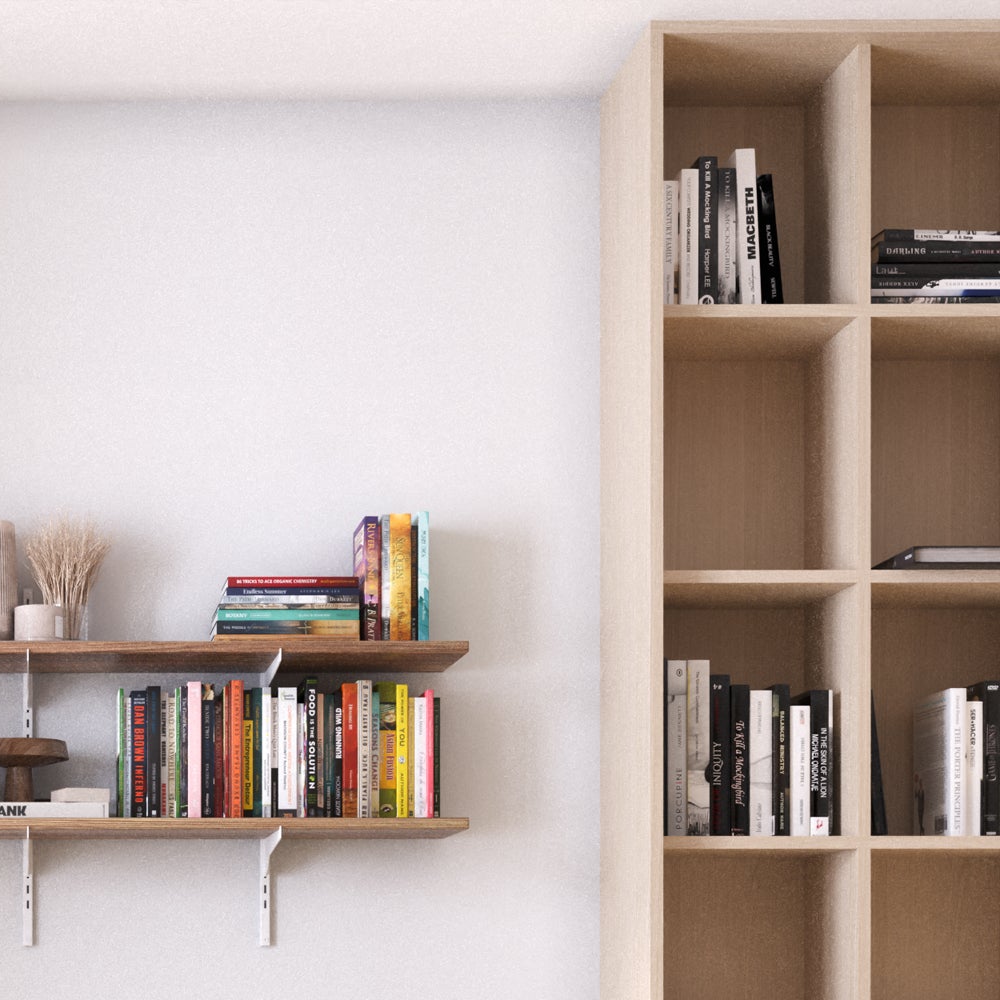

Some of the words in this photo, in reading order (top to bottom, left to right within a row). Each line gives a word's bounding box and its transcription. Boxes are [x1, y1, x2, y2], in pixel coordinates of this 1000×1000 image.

[703, 160, 711, 169] To
[703, 171, 711, 181] Kill
[724, 171, 731, 184] TO
[703, 191, 711, 222] Mocking
[703, 224, 711, 239] Bird
[745, 187, 756, 260] MACBETH
[703, 248, 711, 274] Harper
[766, 244, 774, 266] BEAUTY
[886, 247, 926, 255] DARLING
[703, 275, 711, 288] LEE
[367, 523, 376, 554] RIVERS
[308, 689, 316, 716] FOOD
[134, 706, 145, 724] DAN
[736, 720, 745, 730] To
[168, 728, 175, 738] TO
[372, 712, 380, 751] SEASONS
[734, 732, 745, 748] Kill
[134, 728, 145, 762] BROWN
[386, 734, 394, 754] Asian
[372, 754, 380, 792] CHANGE
[386, 756, 394, 780] Fusion
[712, 742, 724, 786] INIQUITY
[820, 766, 827, 776] OF
[134, 765, 145, 803] INFERNO
[732, 756, 745, 806] Mockingbird
